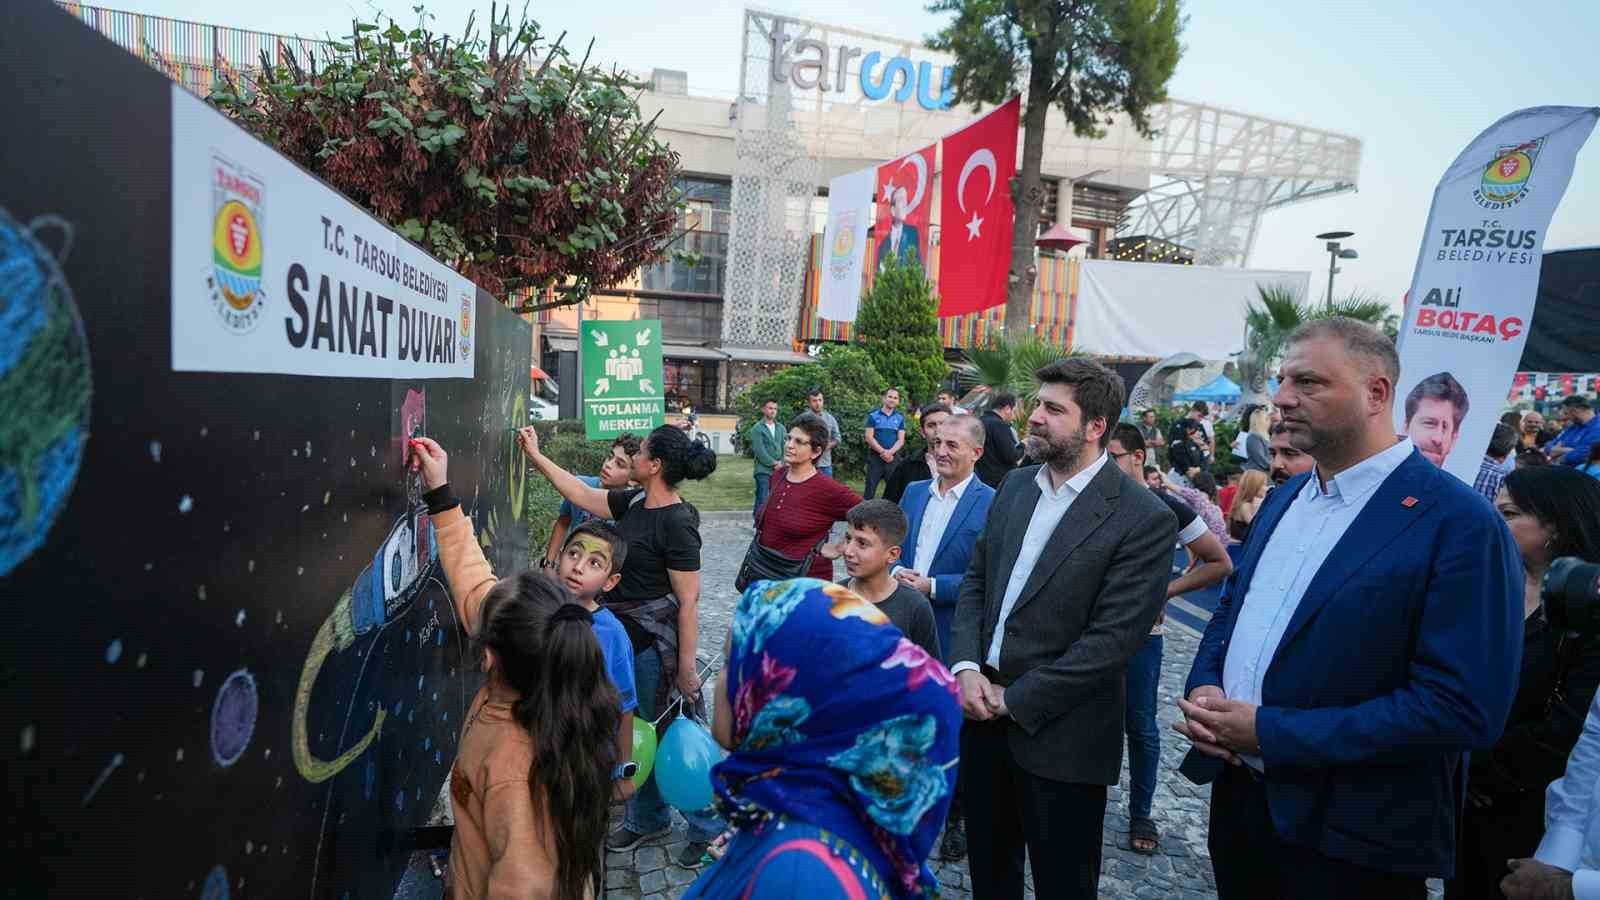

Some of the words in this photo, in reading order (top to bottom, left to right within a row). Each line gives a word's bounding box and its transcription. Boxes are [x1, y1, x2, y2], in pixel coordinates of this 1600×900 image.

[321, 215, 349, 259] T.C.
[354, 234, 400, 283] TARSUS
[1441, 229, 1537, 250] TARSUS
[285, 263, 394, 360] SANAT
[398, 304, 457, 365] DUVARI
[1416, 308, 1523, 341] BOLTAÇ
[590, 402, 660, 416] TOPLANMA
[599, 415, 654, 432] MERKEZİ
